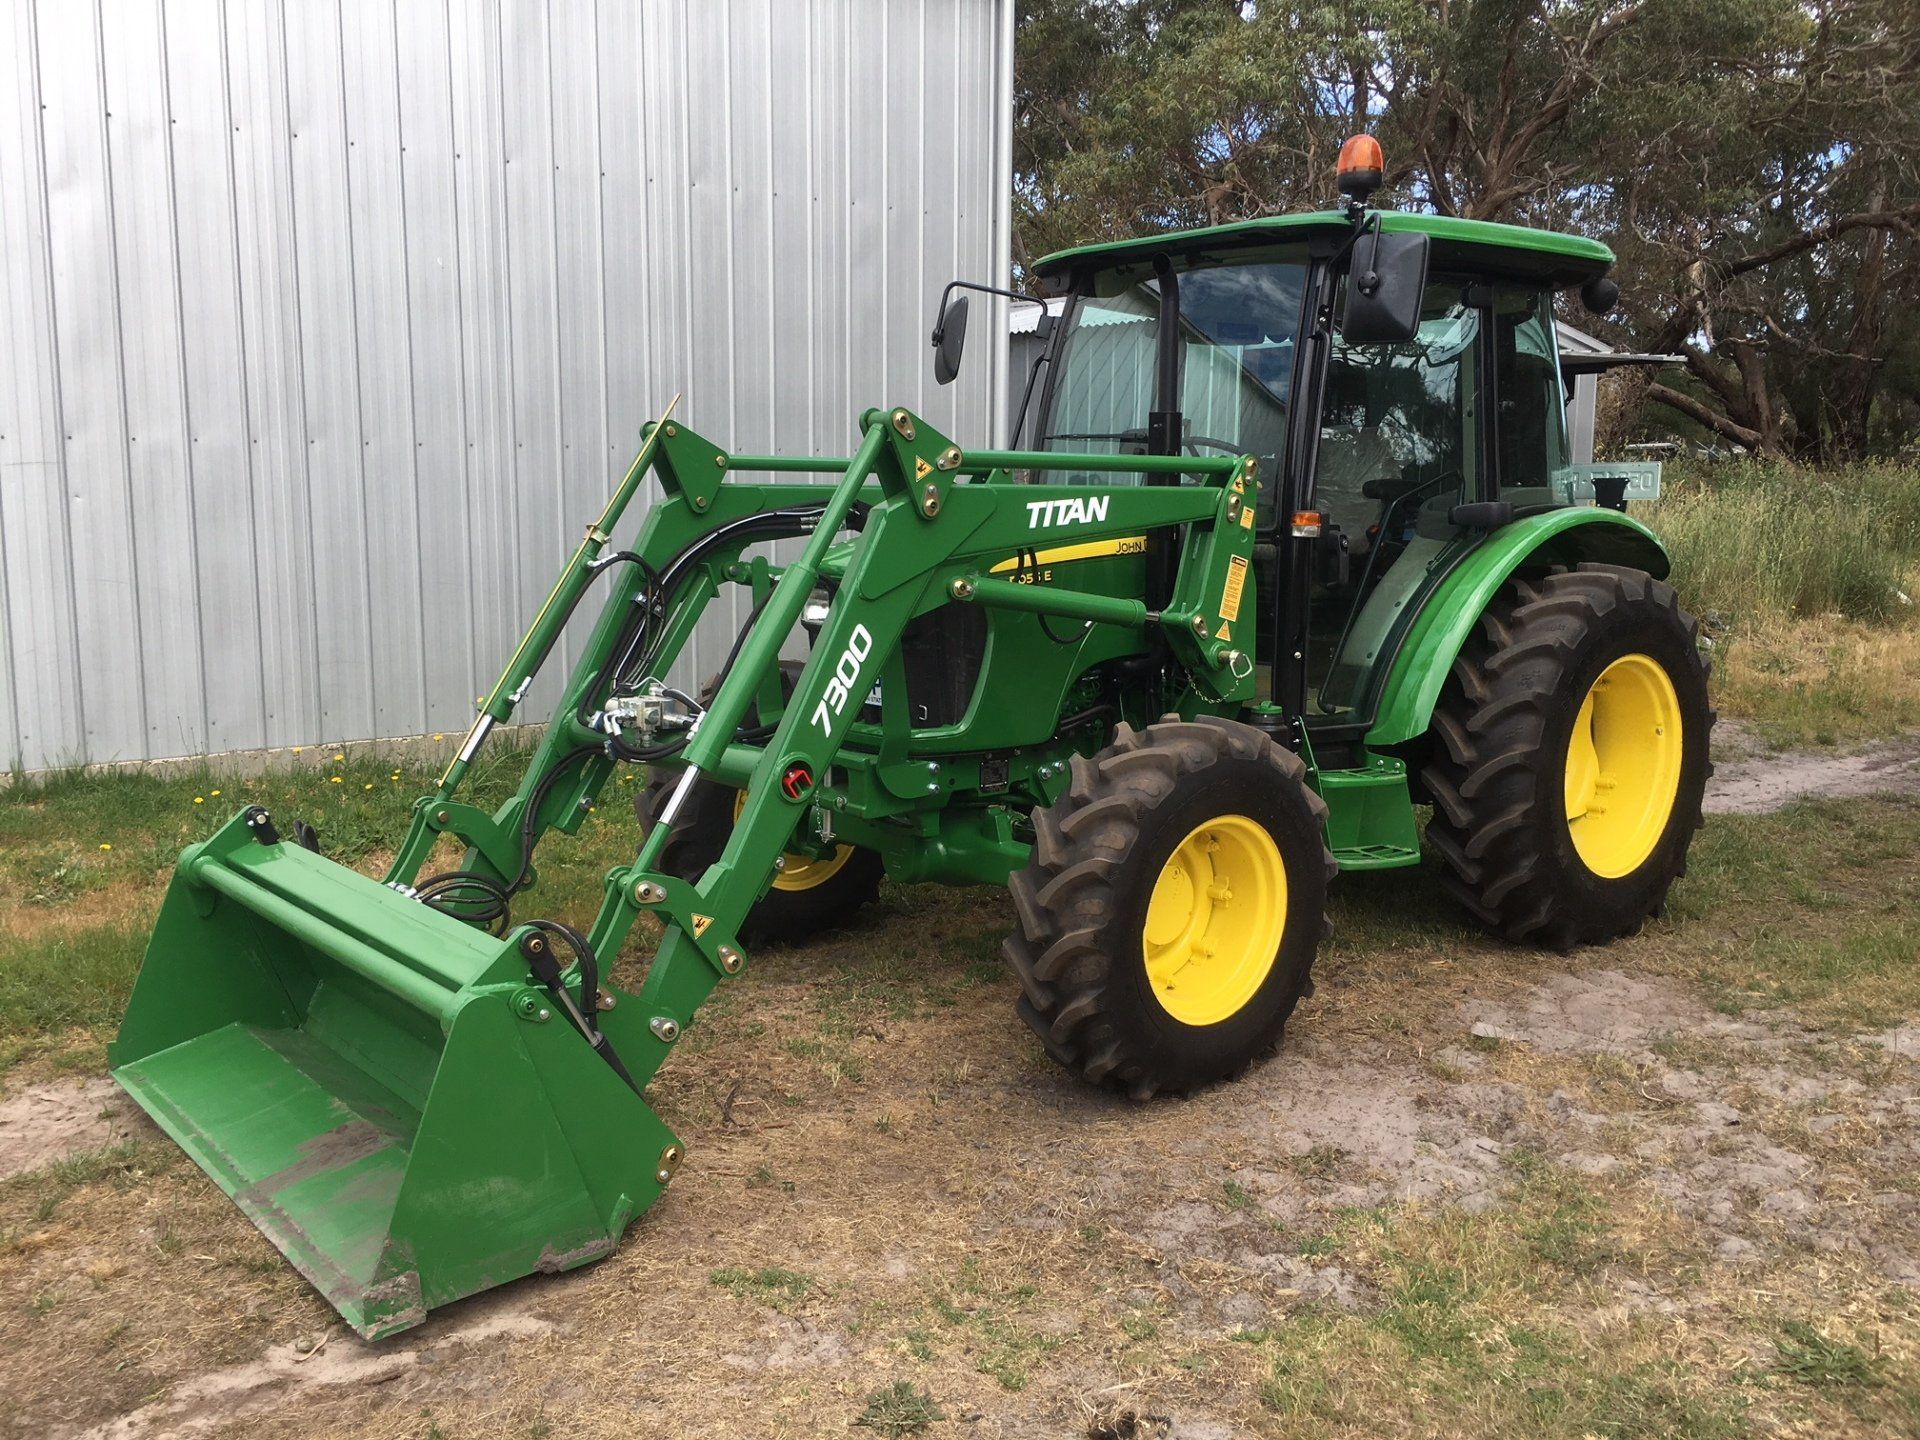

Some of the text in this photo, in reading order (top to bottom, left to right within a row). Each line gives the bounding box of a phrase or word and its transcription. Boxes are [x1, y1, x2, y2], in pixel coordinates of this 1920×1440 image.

[1026, 496, 1110, 529] TITAN
[1115, 541, 1142, 553] JOHN
[810, 623, 873, 738] 7300
